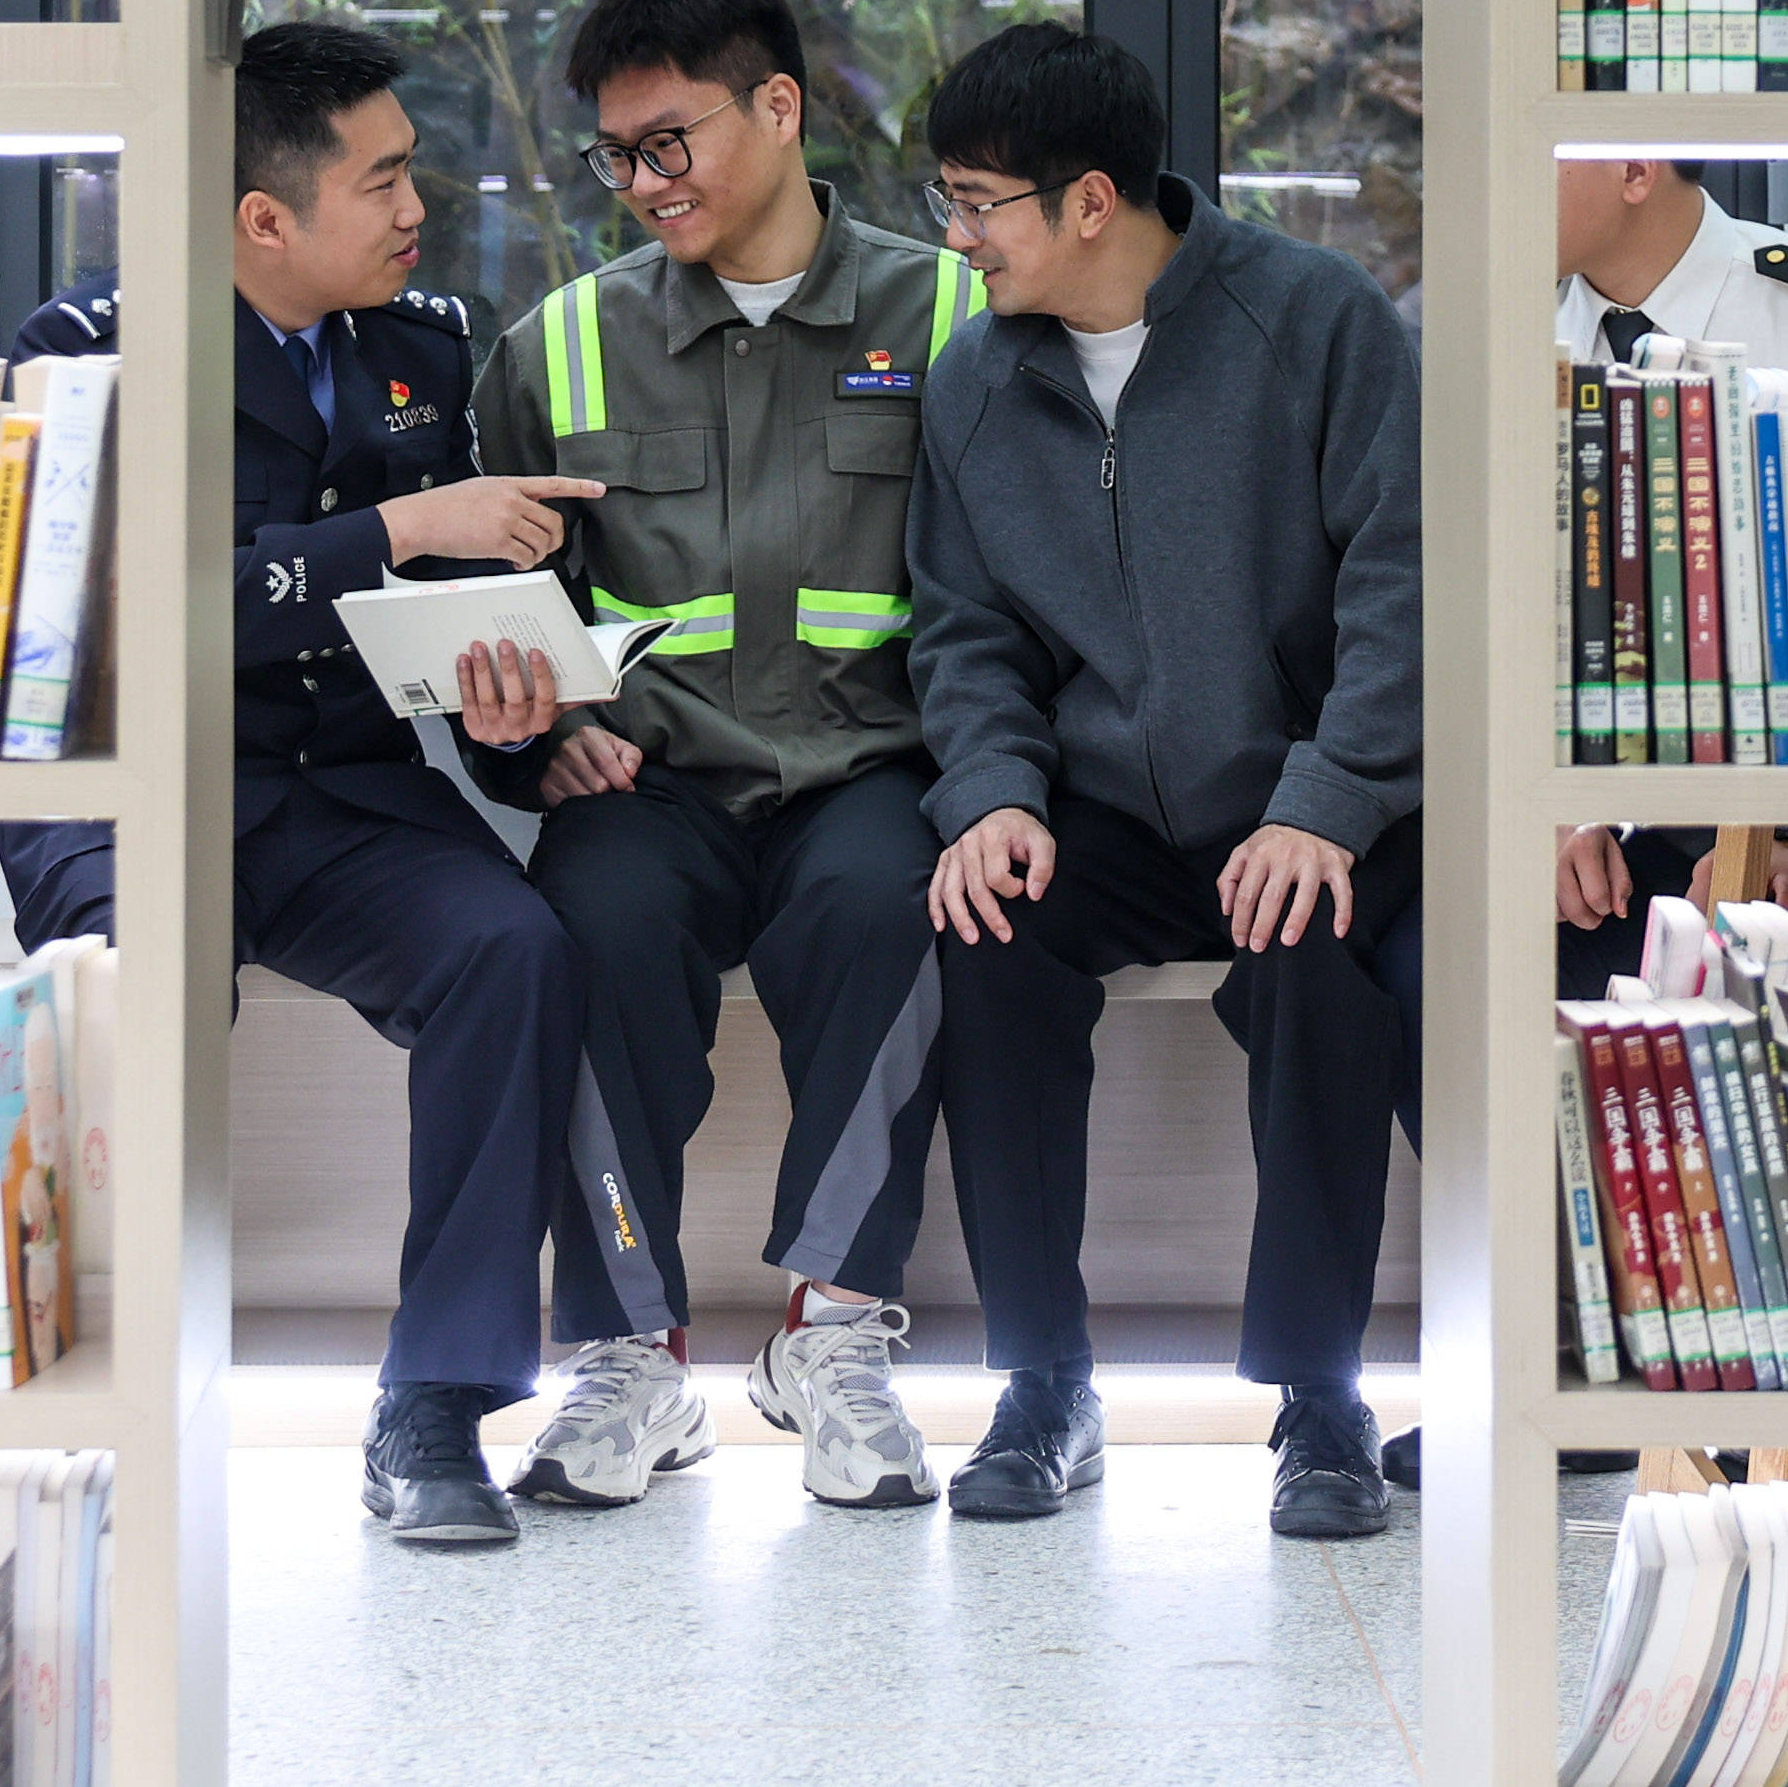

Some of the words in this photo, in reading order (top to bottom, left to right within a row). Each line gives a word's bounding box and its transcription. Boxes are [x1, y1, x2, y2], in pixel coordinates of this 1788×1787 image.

[1653, 457, 1677, 552] 三国不演义
[1687, 457, 1712, 552] 三国不演义
[293, 555, 308, 603] POLICE
[602, 1172, 636, 1249] CORDURA
